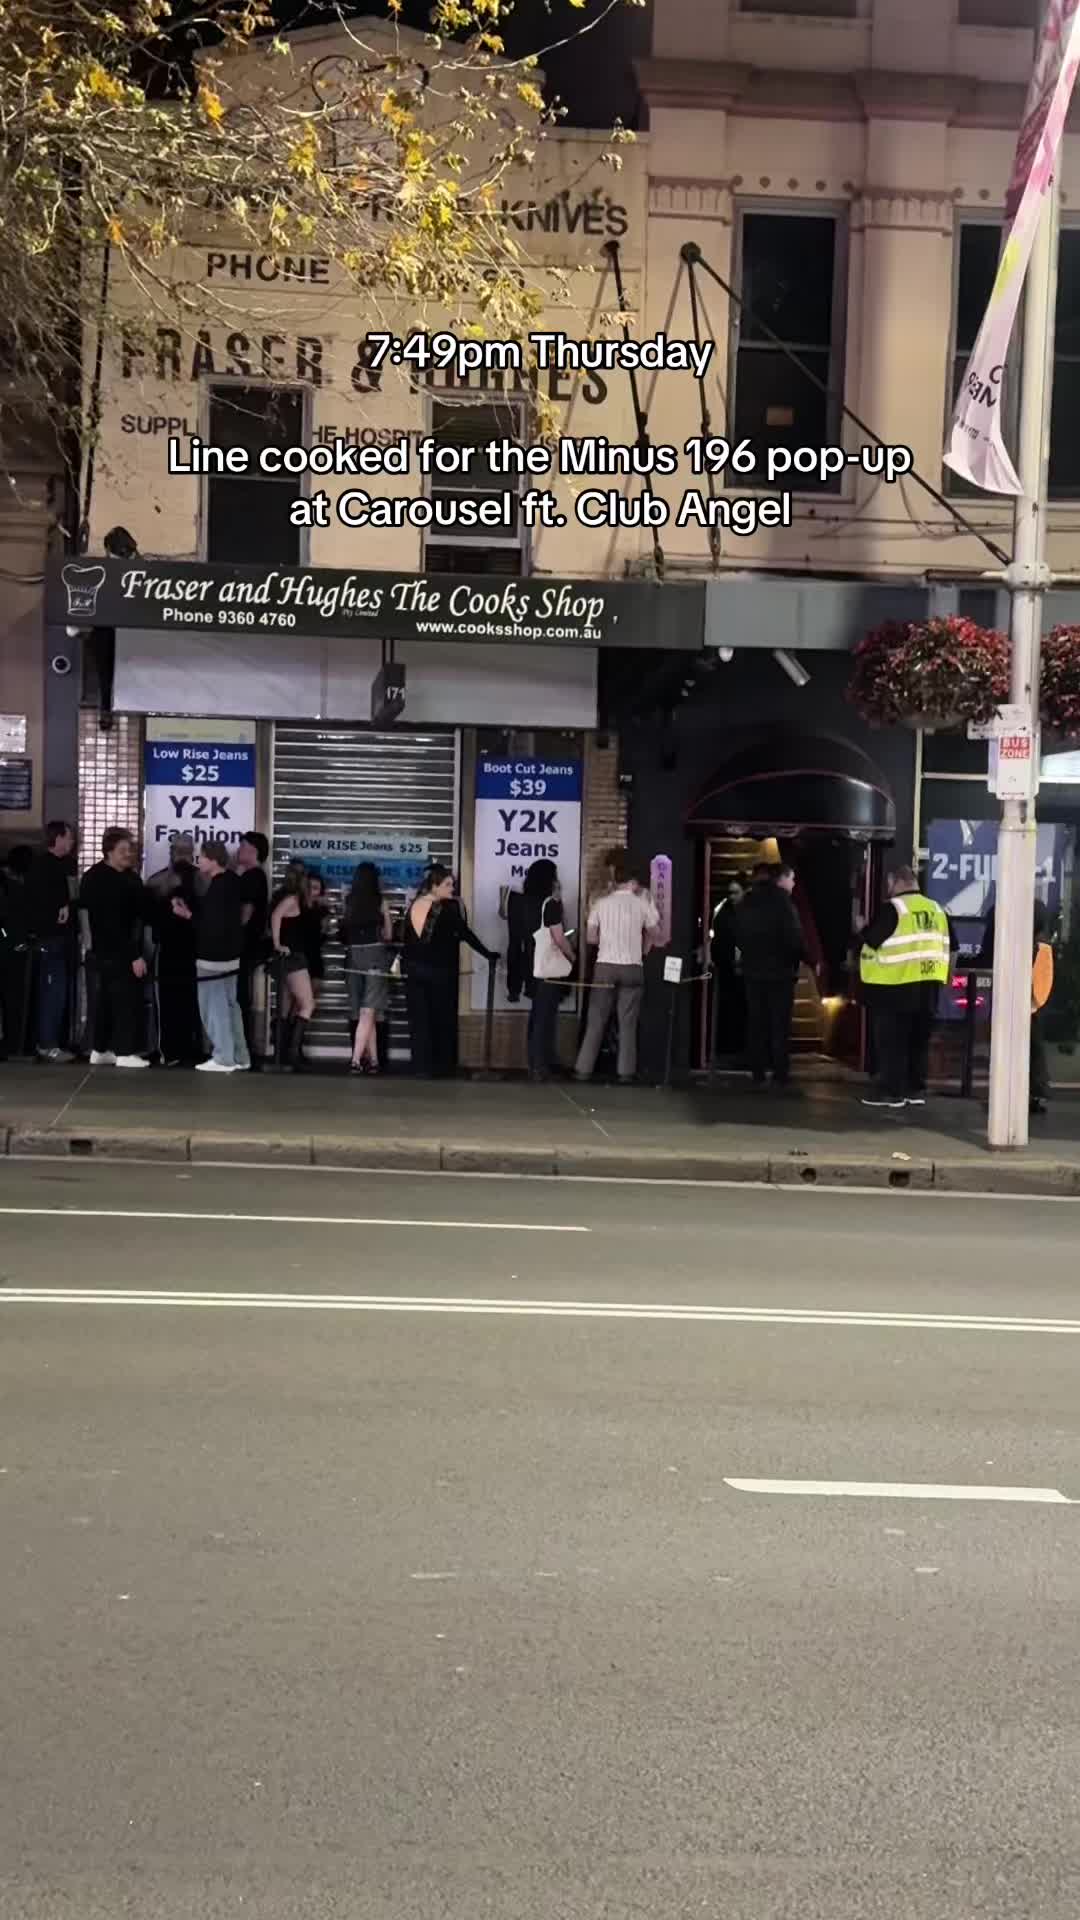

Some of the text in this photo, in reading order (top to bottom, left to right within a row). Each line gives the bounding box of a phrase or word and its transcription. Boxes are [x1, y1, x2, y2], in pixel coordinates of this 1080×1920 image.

[501, 199, 628, 236] KNIVES
[207, 253, 329, 284] PHONE
[121, 570, 604, 627] Fraser and Hughes The Cooks Shop
[163, 608, 296, 627] Phone 9360 4760
[415, 621, 602, 640] www.cooksshop.com.au
[1002, 737, 1029, 748] BUS
[153, 748, 249, 761] Low Rise Jeans
[1000, 749, 1030, 758] ZONE
[181, 764, 219, 783] $25
[483, 763, 573, 775] Boot Cut Jeans
[509, 779, 547, 798] $39
[169, 795, 231, 820] Y2K
[498, 809, 558, 833] Y2K
[293, 840, 423, 854] LOW RISE Jeans $25
[494, 839, 559, 857] Jeans
